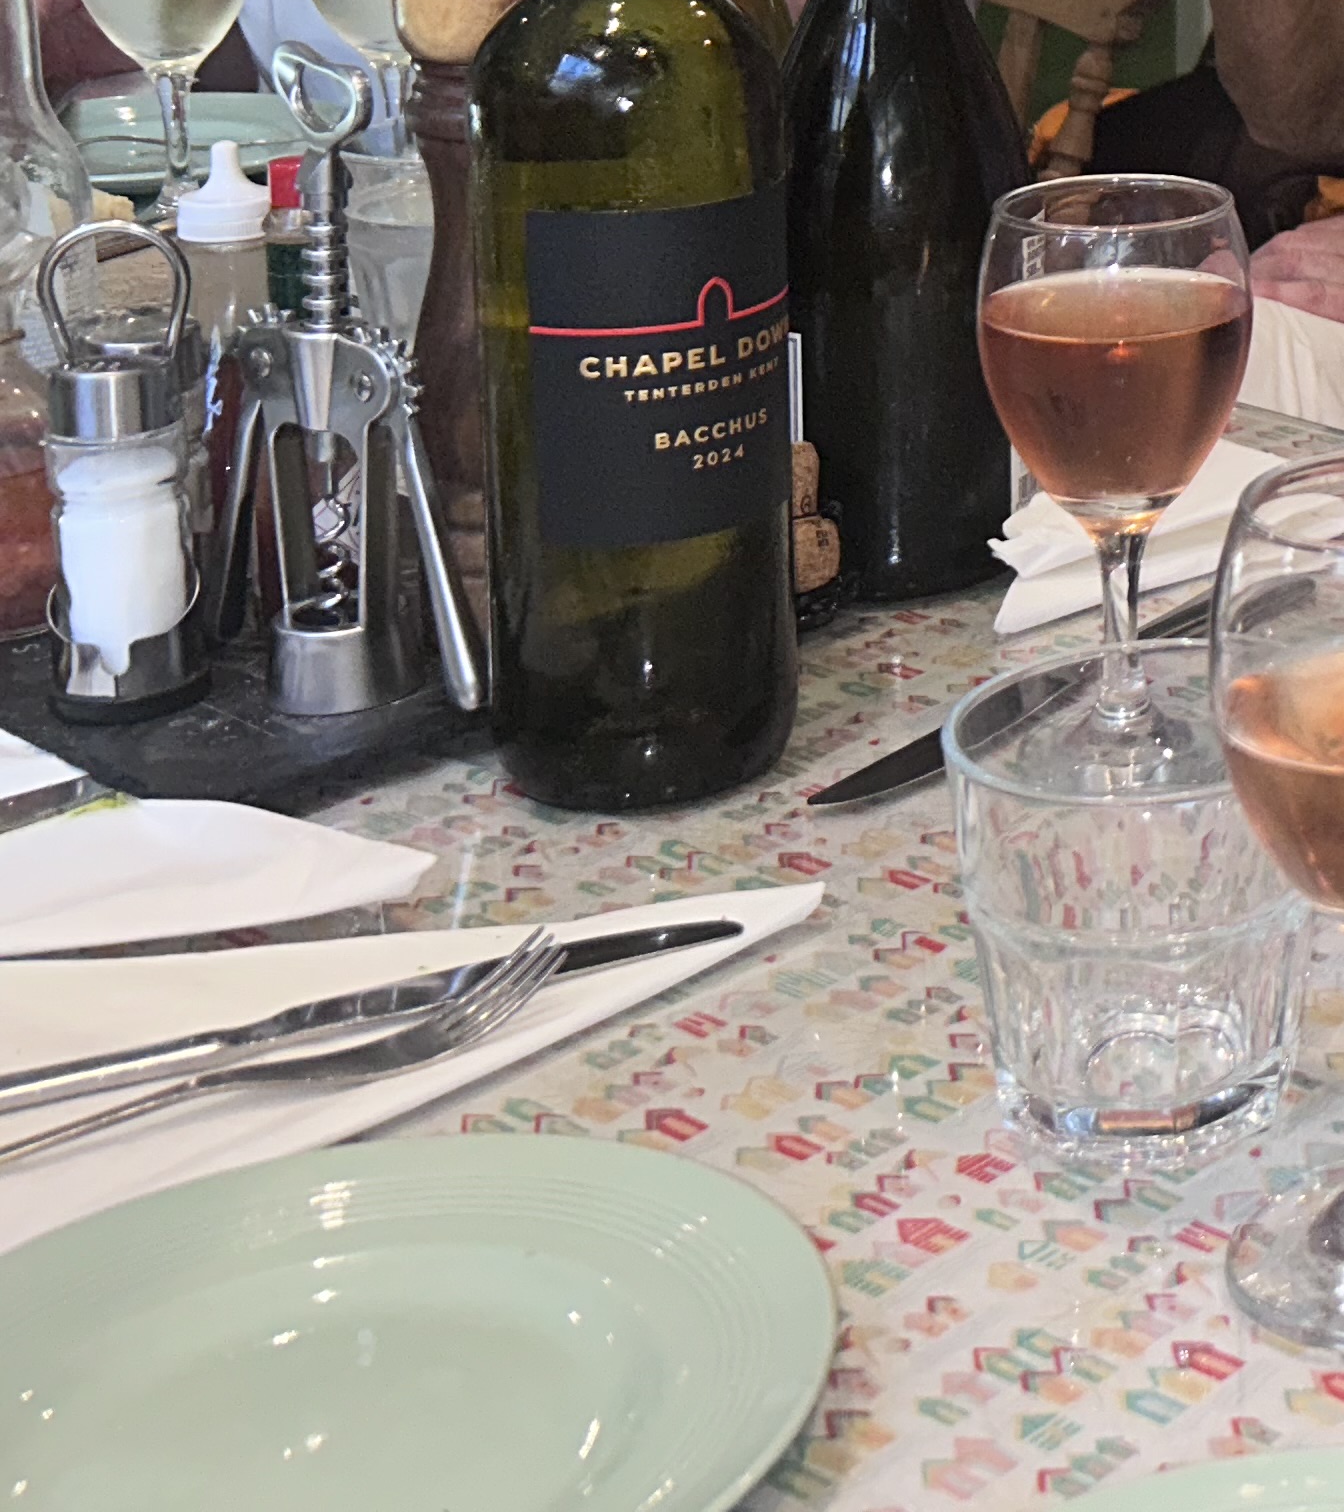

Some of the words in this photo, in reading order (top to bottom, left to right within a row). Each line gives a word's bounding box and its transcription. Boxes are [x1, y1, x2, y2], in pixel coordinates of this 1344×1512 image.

[579, 344, 726, 380] CHAPEL
[624, 372, 743, 402] TENTERDEN
[655, 408, 768, 450] BACCHUS
[693, 444, 745, 470] 2024
